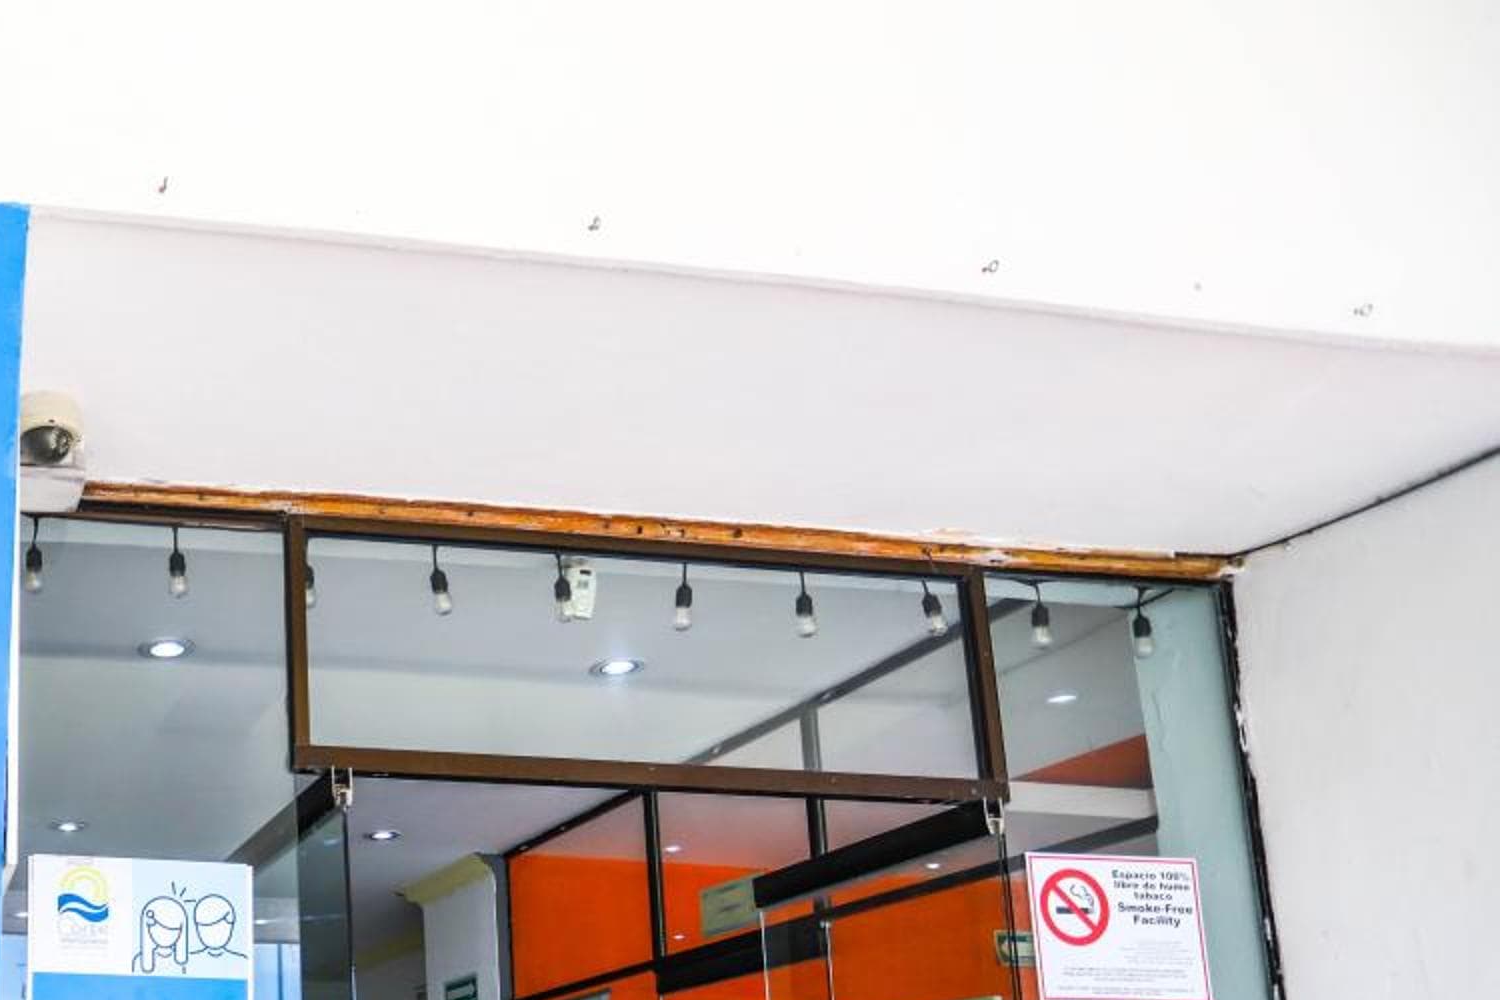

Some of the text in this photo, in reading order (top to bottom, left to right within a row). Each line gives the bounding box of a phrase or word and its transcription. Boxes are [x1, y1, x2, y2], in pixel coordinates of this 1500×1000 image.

[1112, 869, 1156, 881] Espacio
[1142, 881, 1156, 890] de
[1117, 901, 1193, 915] Smoke-Free
[1133, 915, 1181, 929] Facility
